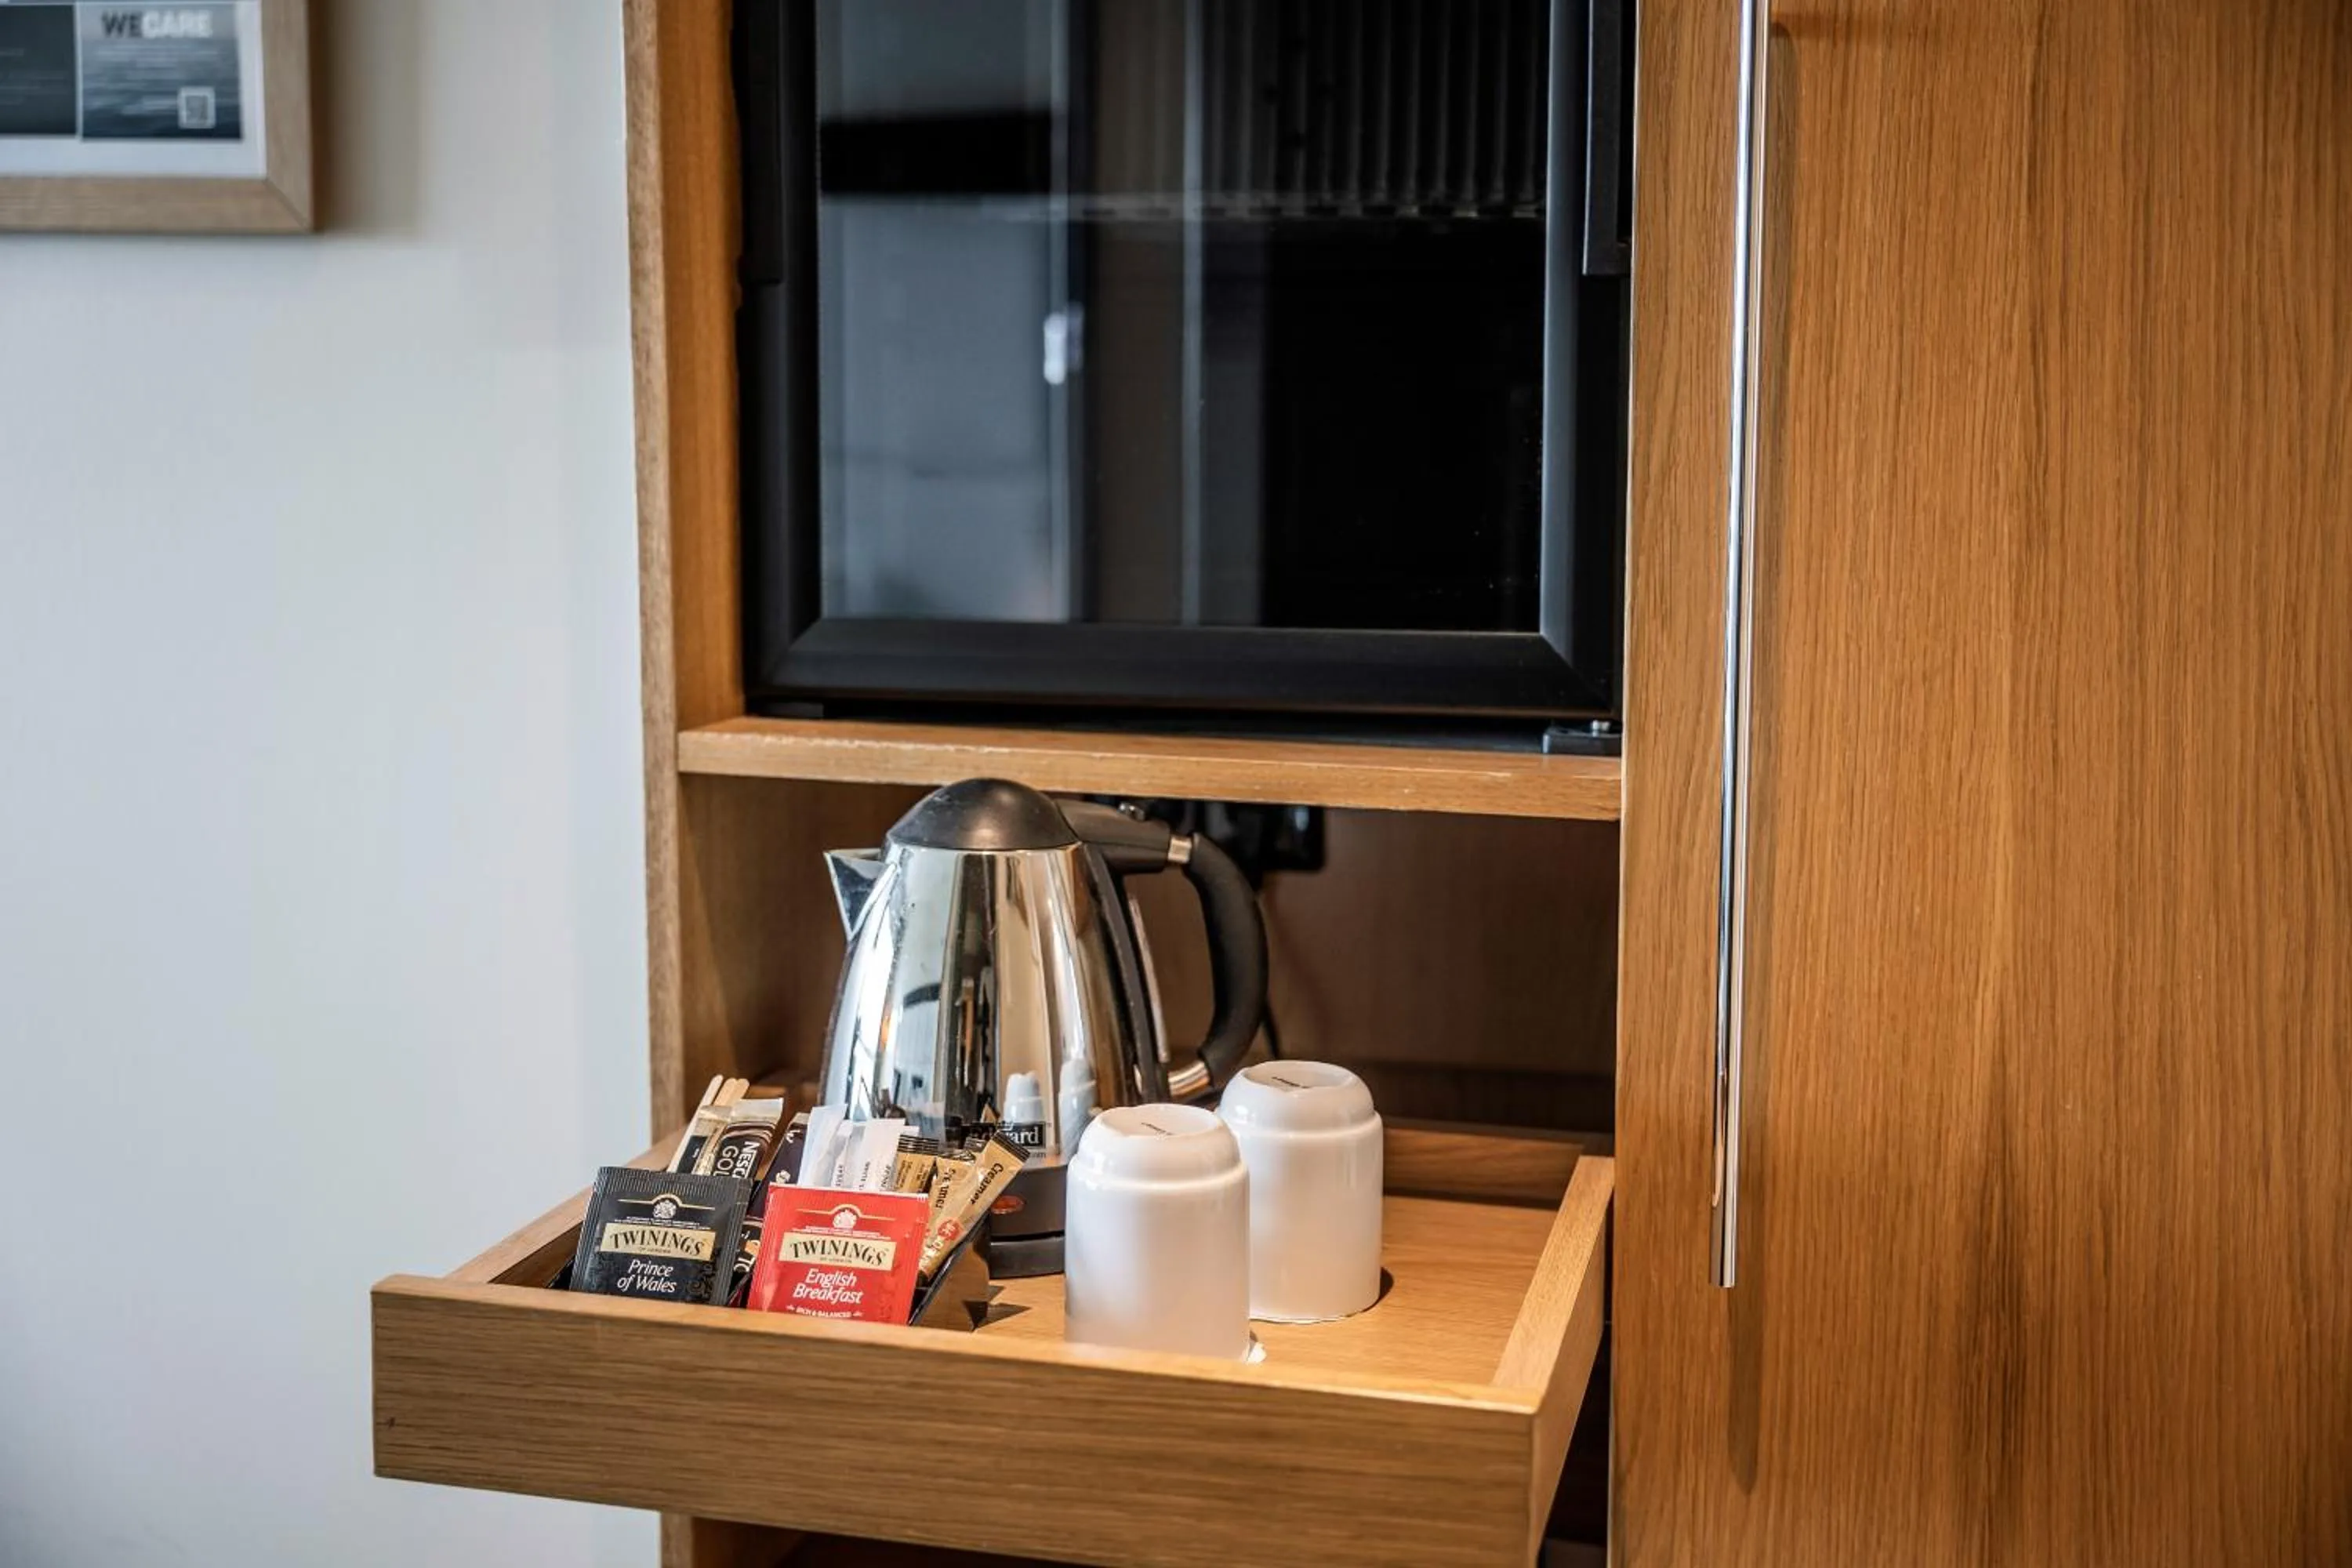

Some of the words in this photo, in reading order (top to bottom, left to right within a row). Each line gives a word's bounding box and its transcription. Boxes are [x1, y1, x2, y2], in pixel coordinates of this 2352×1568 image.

[101, 10, 212, 38] WECARE
[971, 1163, 1004, 1205] Creamer
[610, 1229, 704, 1255] TWININGS
[789, 1240, 887, 1266] TWININGS
[628, 1258, 673, 1276] Prince
[805, 1268, 857, 1288] English
[617, 1274, 634, 1291] of
[637, 1275, 677, 1292] Wales
[793, 1283, 863, 1305] Breakfast
